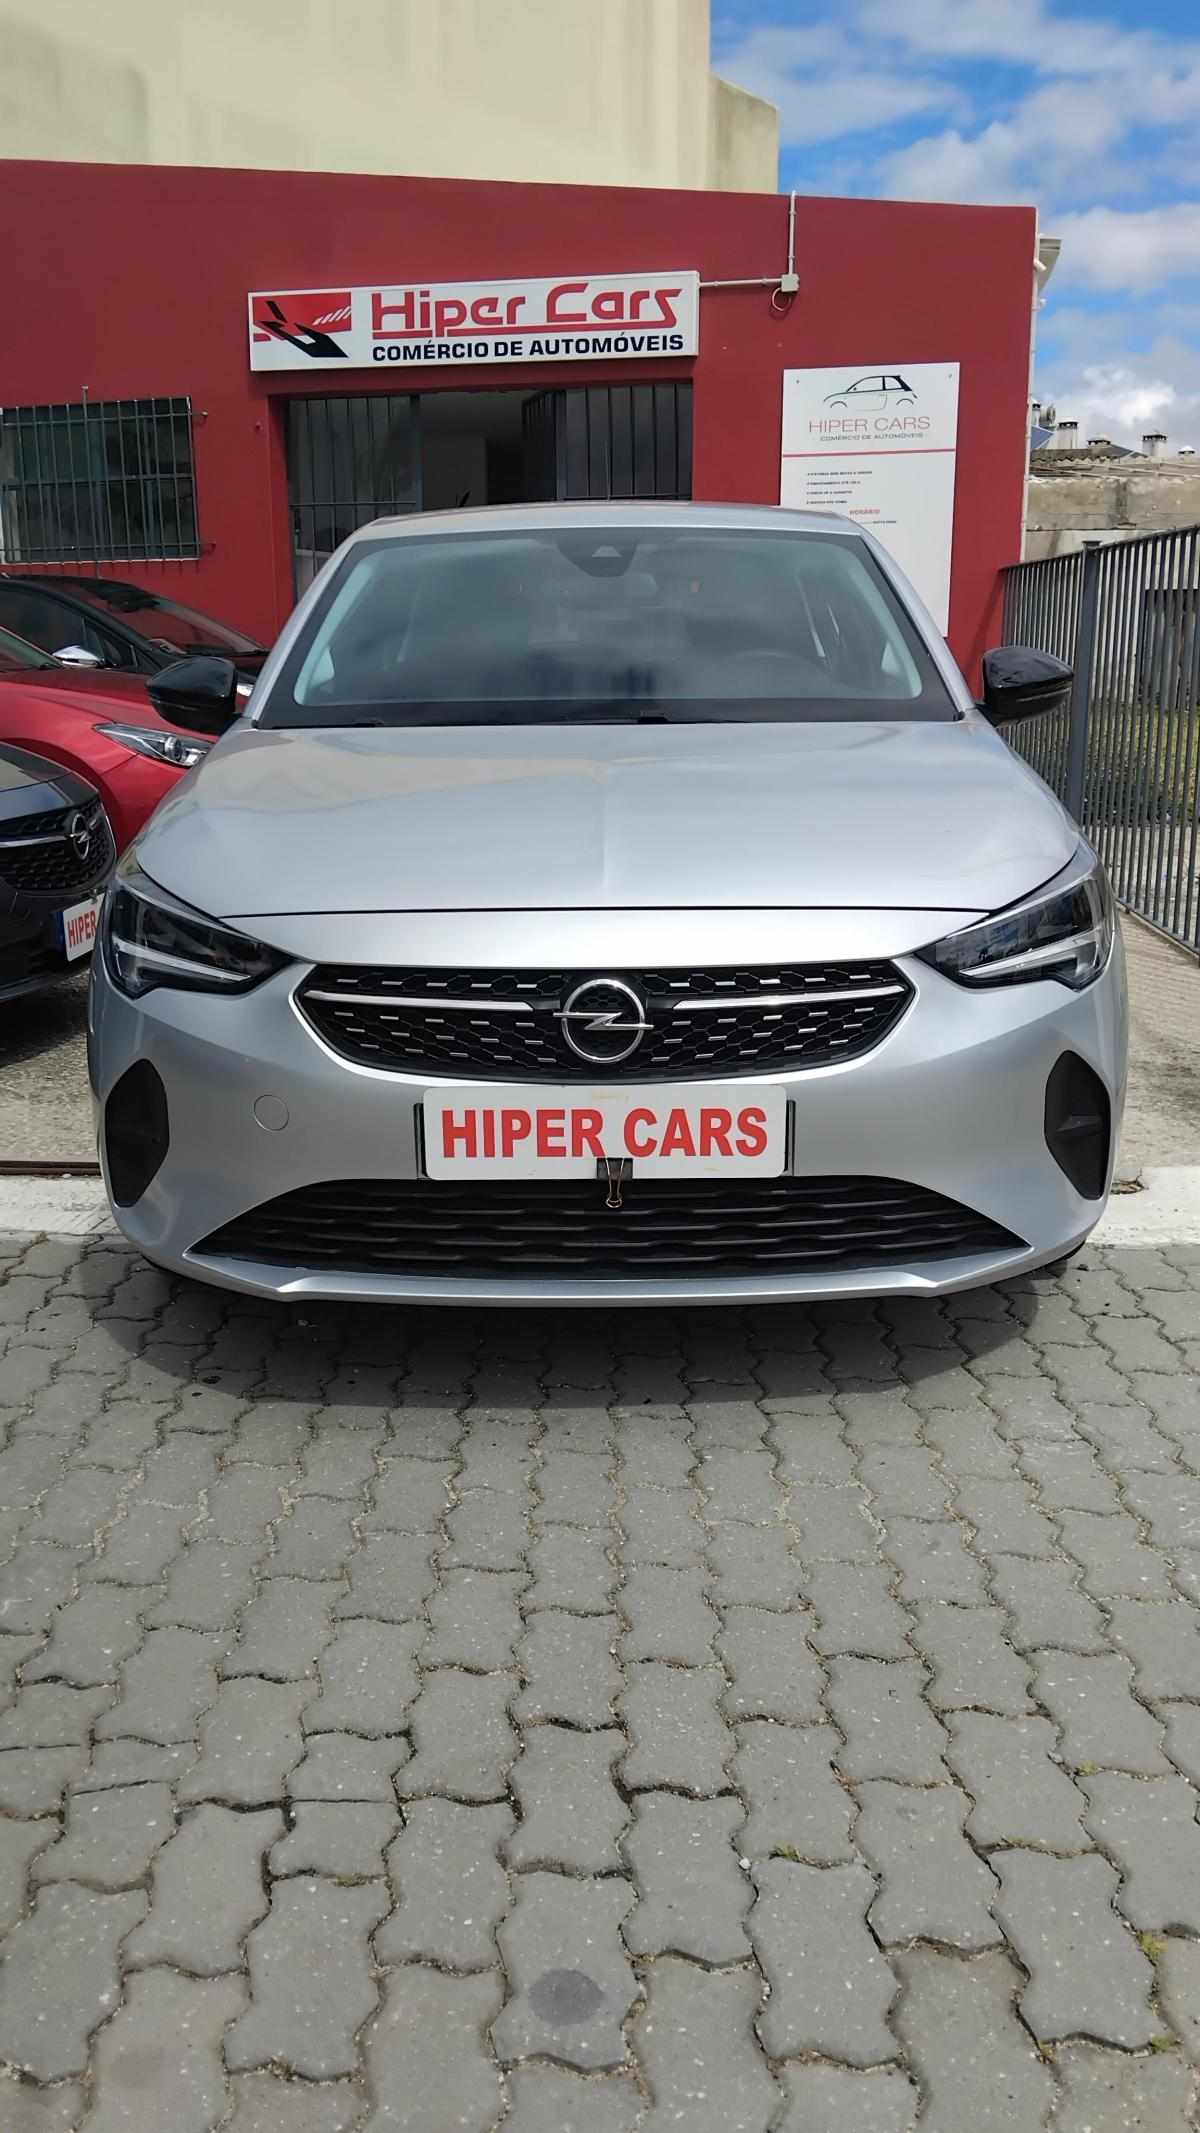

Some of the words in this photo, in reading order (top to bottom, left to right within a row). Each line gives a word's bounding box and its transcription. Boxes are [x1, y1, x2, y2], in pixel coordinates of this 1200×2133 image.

[371, 290, 526, 338] Hiper
[546, 282, 683, 329] Cars
[372, 340, 489, 361] COMÉRCIO
[494, 341, 523, 357] DE
[529, 332, 684, 356] AUTOMÓVEIS
[808, 418, 868, 433] HIPER
[873, 416, 931, 431] CARS
[67, 910, 97, 948] HIPER
[441, 1108, 606, 1159] HIPER
[623, 1107, 769, 1158] CARS
